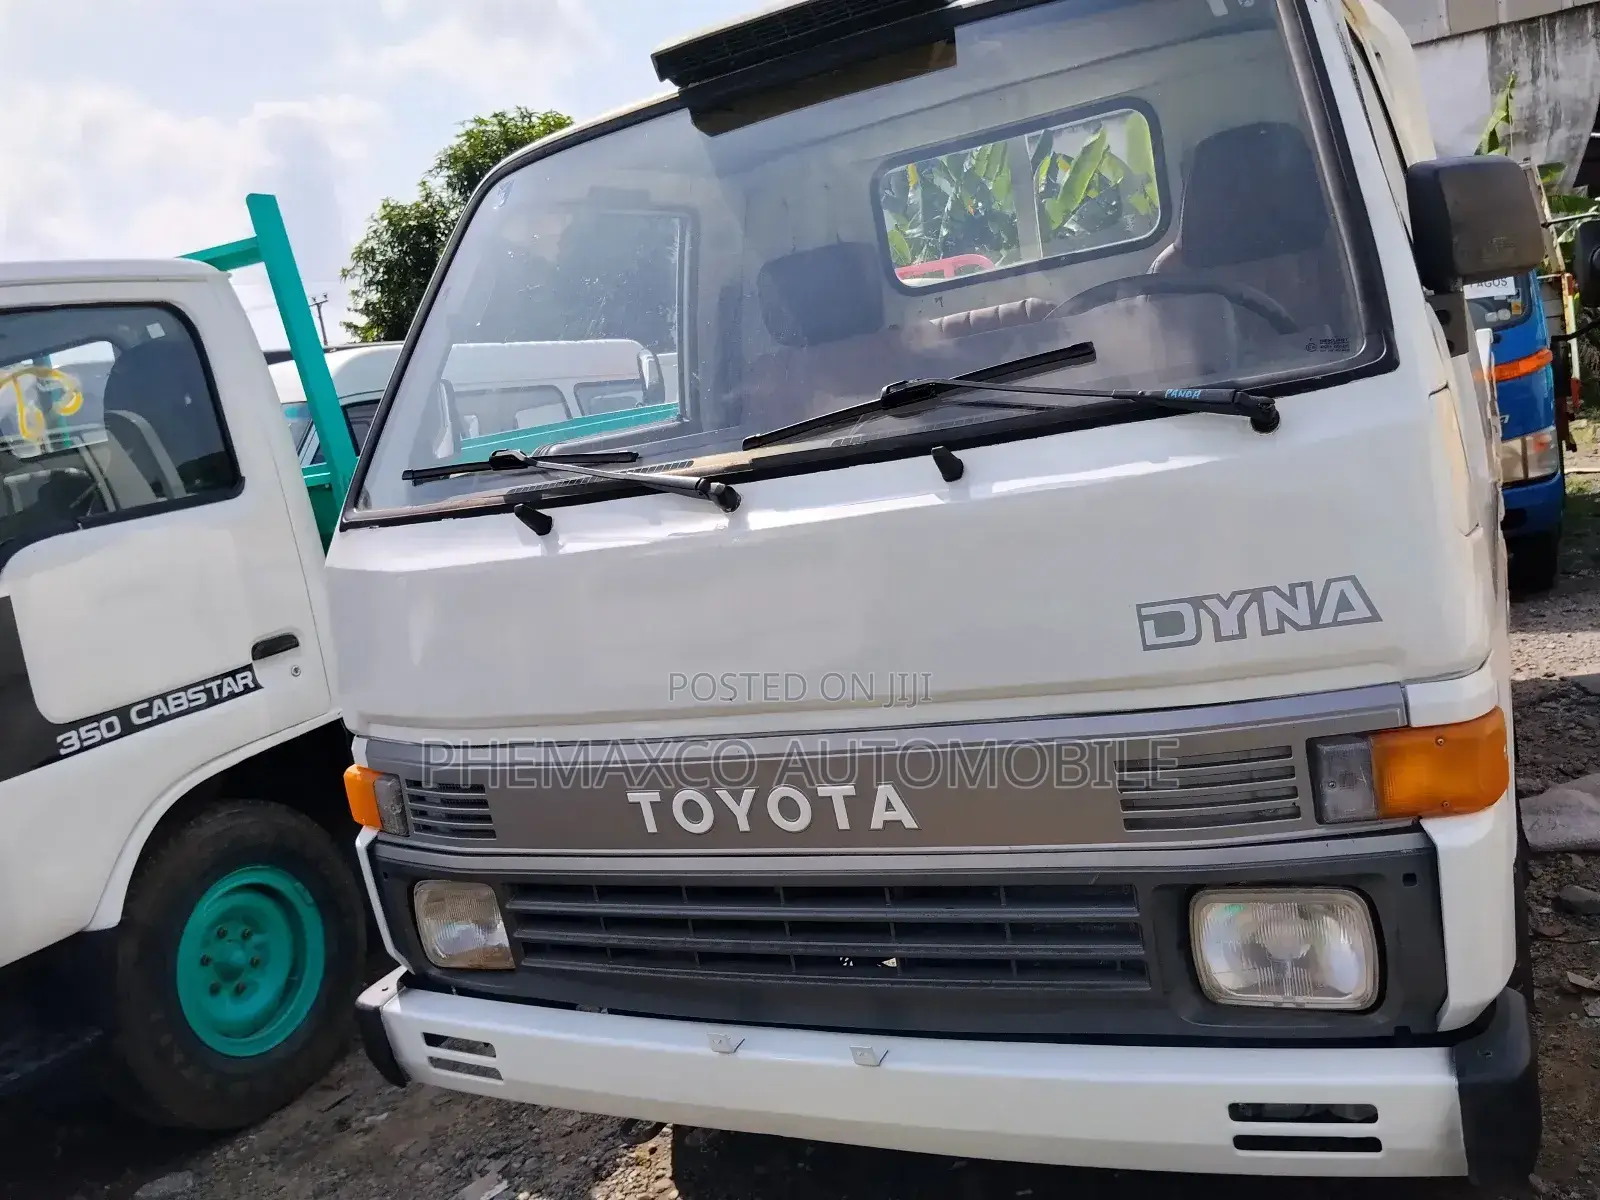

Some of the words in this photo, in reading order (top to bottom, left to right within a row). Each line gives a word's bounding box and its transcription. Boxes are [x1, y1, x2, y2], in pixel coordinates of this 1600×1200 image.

[1135, 574, 1383, 651] DYNA
[57, 715, 122, 755] 350
[130, 670, 255, 725] CABSTAR
[626, 783, 921, 835] TOYOTA
